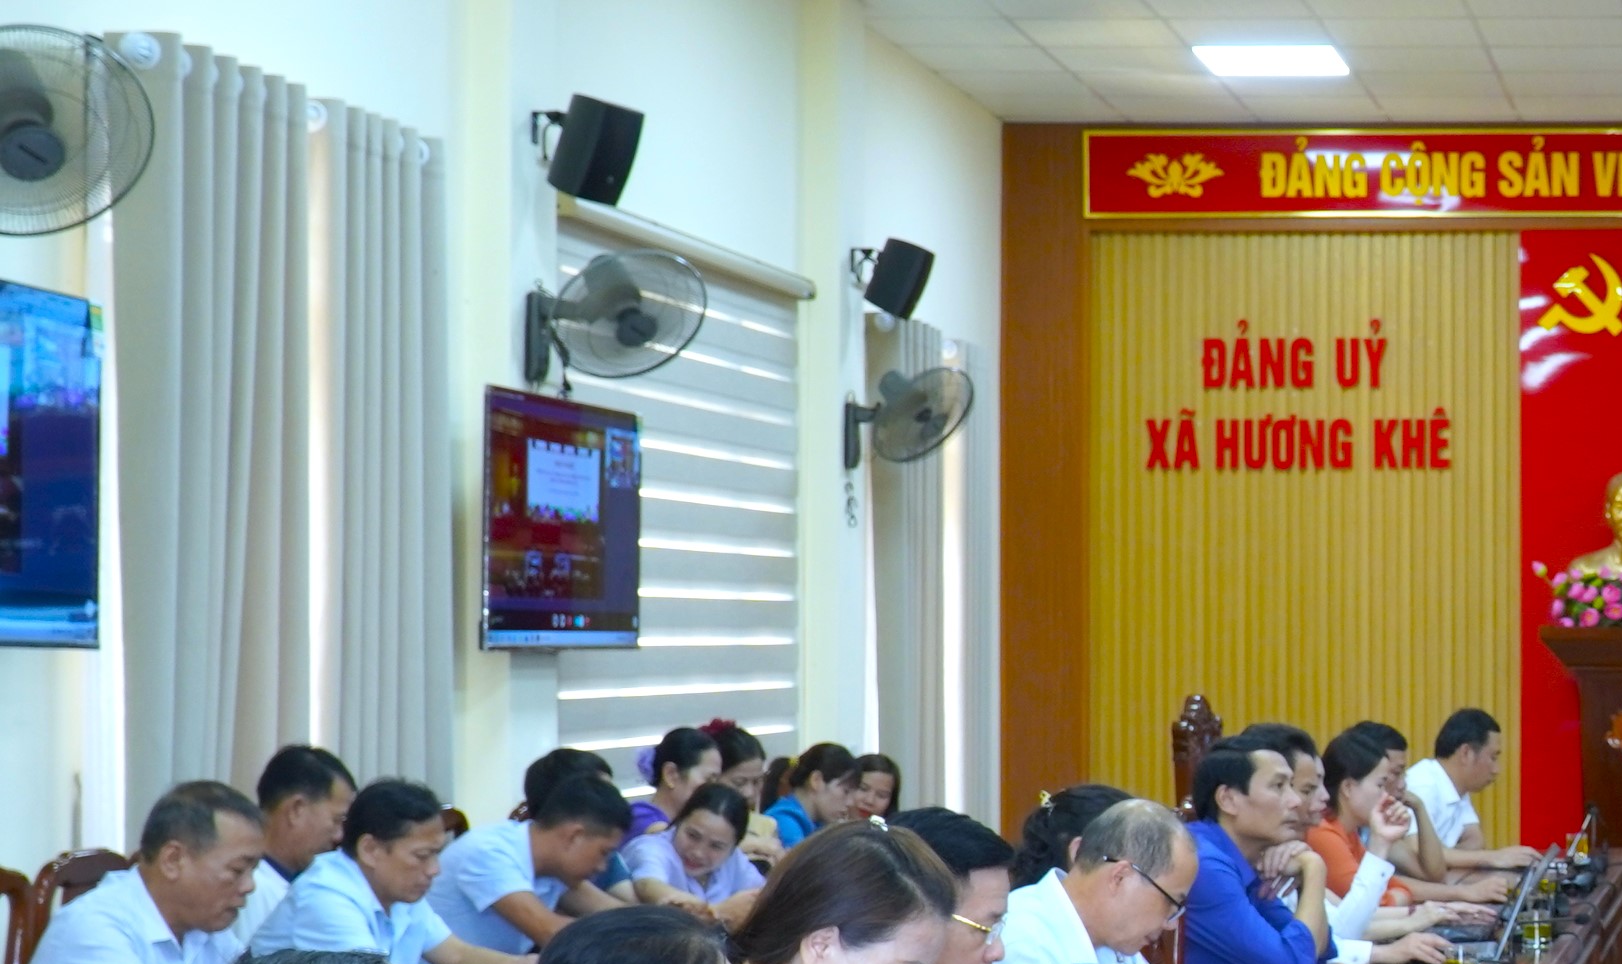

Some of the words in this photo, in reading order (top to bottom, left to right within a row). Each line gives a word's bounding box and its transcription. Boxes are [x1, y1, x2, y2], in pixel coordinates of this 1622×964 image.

[1260, 136, 1368, 198] ĐẢNG
[1380, 141, 1486, 206] CỘNG
[1498, 136, 1580, 198] SẢN
[1202, 319, 1314, 389] ĐẢNG
[1336, 318, 1388, 389] UỶ
[1146, 407, 1200, 470] XÃ
[1215, 413, 1354, 470] HƯƠNG
[1373, 406, 1452, 470] KHÊ
